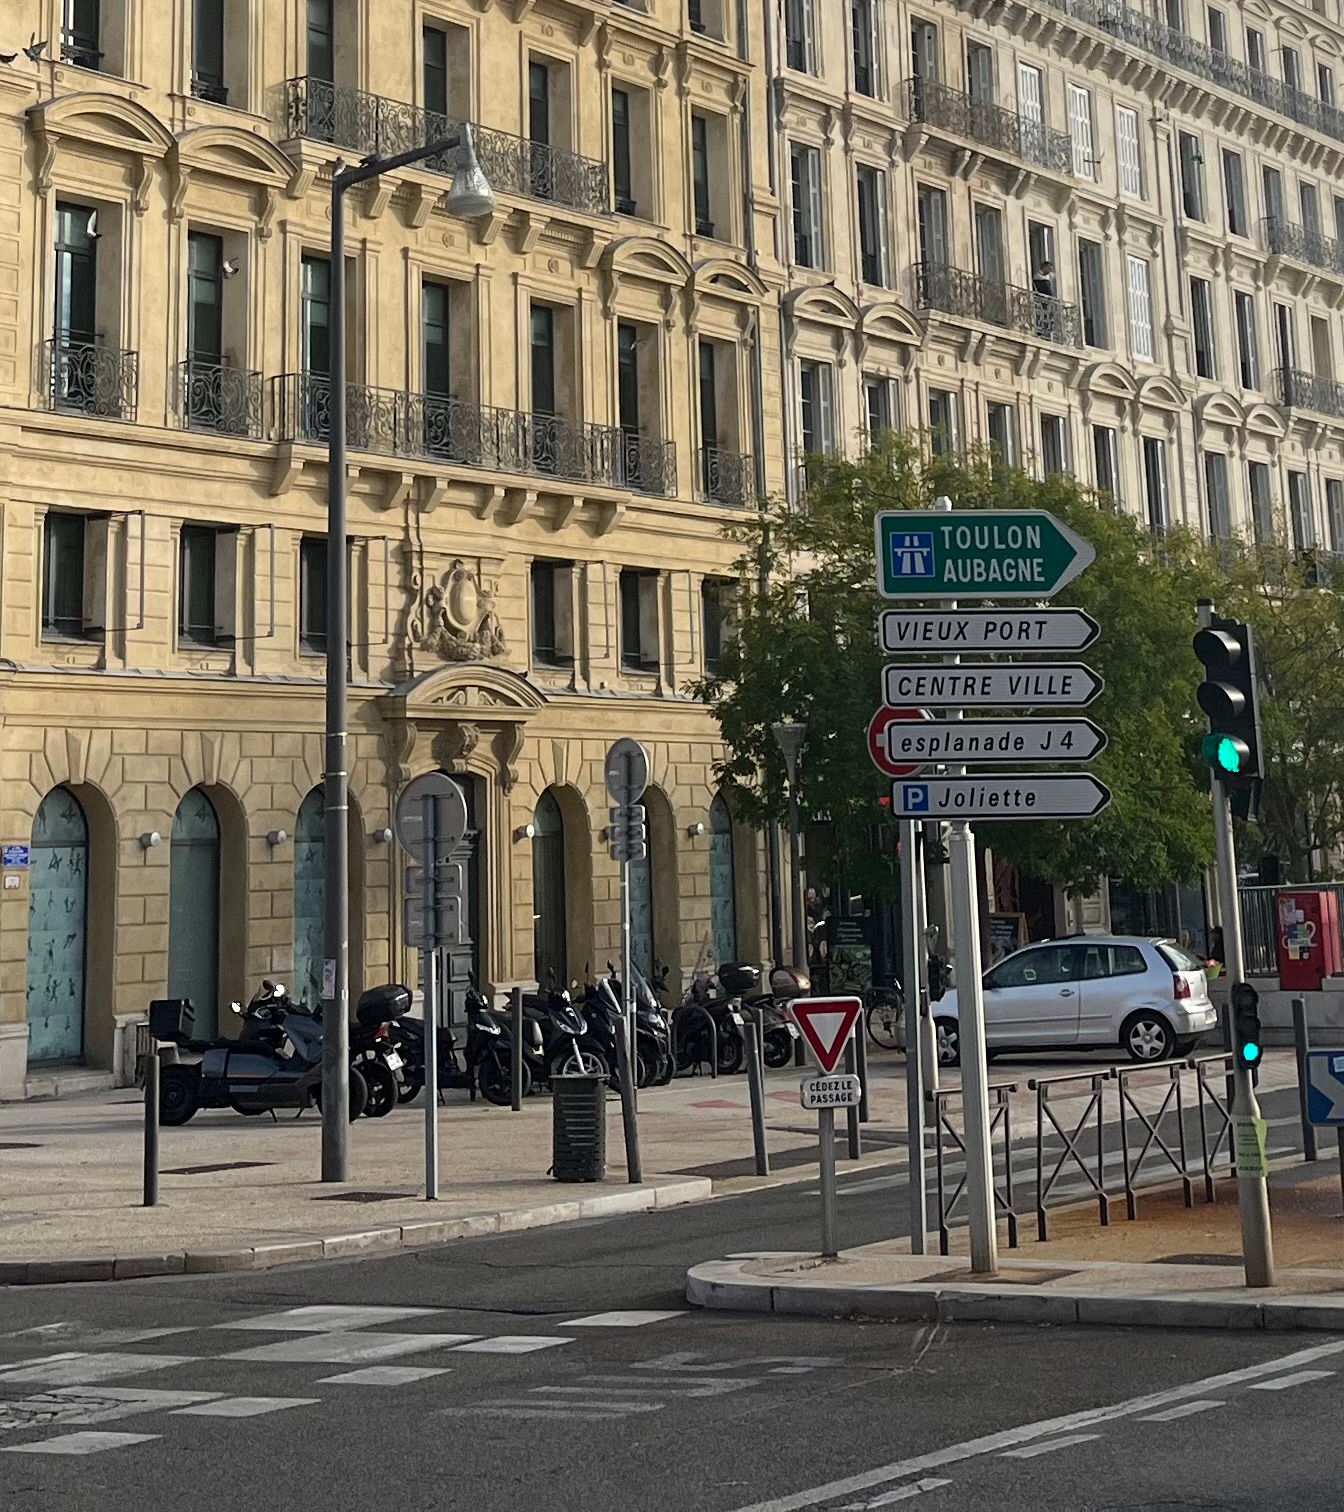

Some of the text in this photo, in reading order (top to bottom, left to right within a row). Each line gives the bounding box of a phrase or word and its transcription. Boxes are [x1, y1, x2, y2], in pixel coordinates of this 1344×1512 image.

[940, 525, 1041, 550] TOULON
[943, 558, 1045, 583] AUBAGNE
[896, 620, 1048, 641] VIEUX PORT
[898, 675, 1073, 696] CENTRE VILLE
[901, 730, 1025, 756] esplanade
[938, 787, 1036, 808] Joliette
[810, 1080, 852, 1092] CÉDEZ LE
[810, 1093, 852, 1104] PASSAGE
